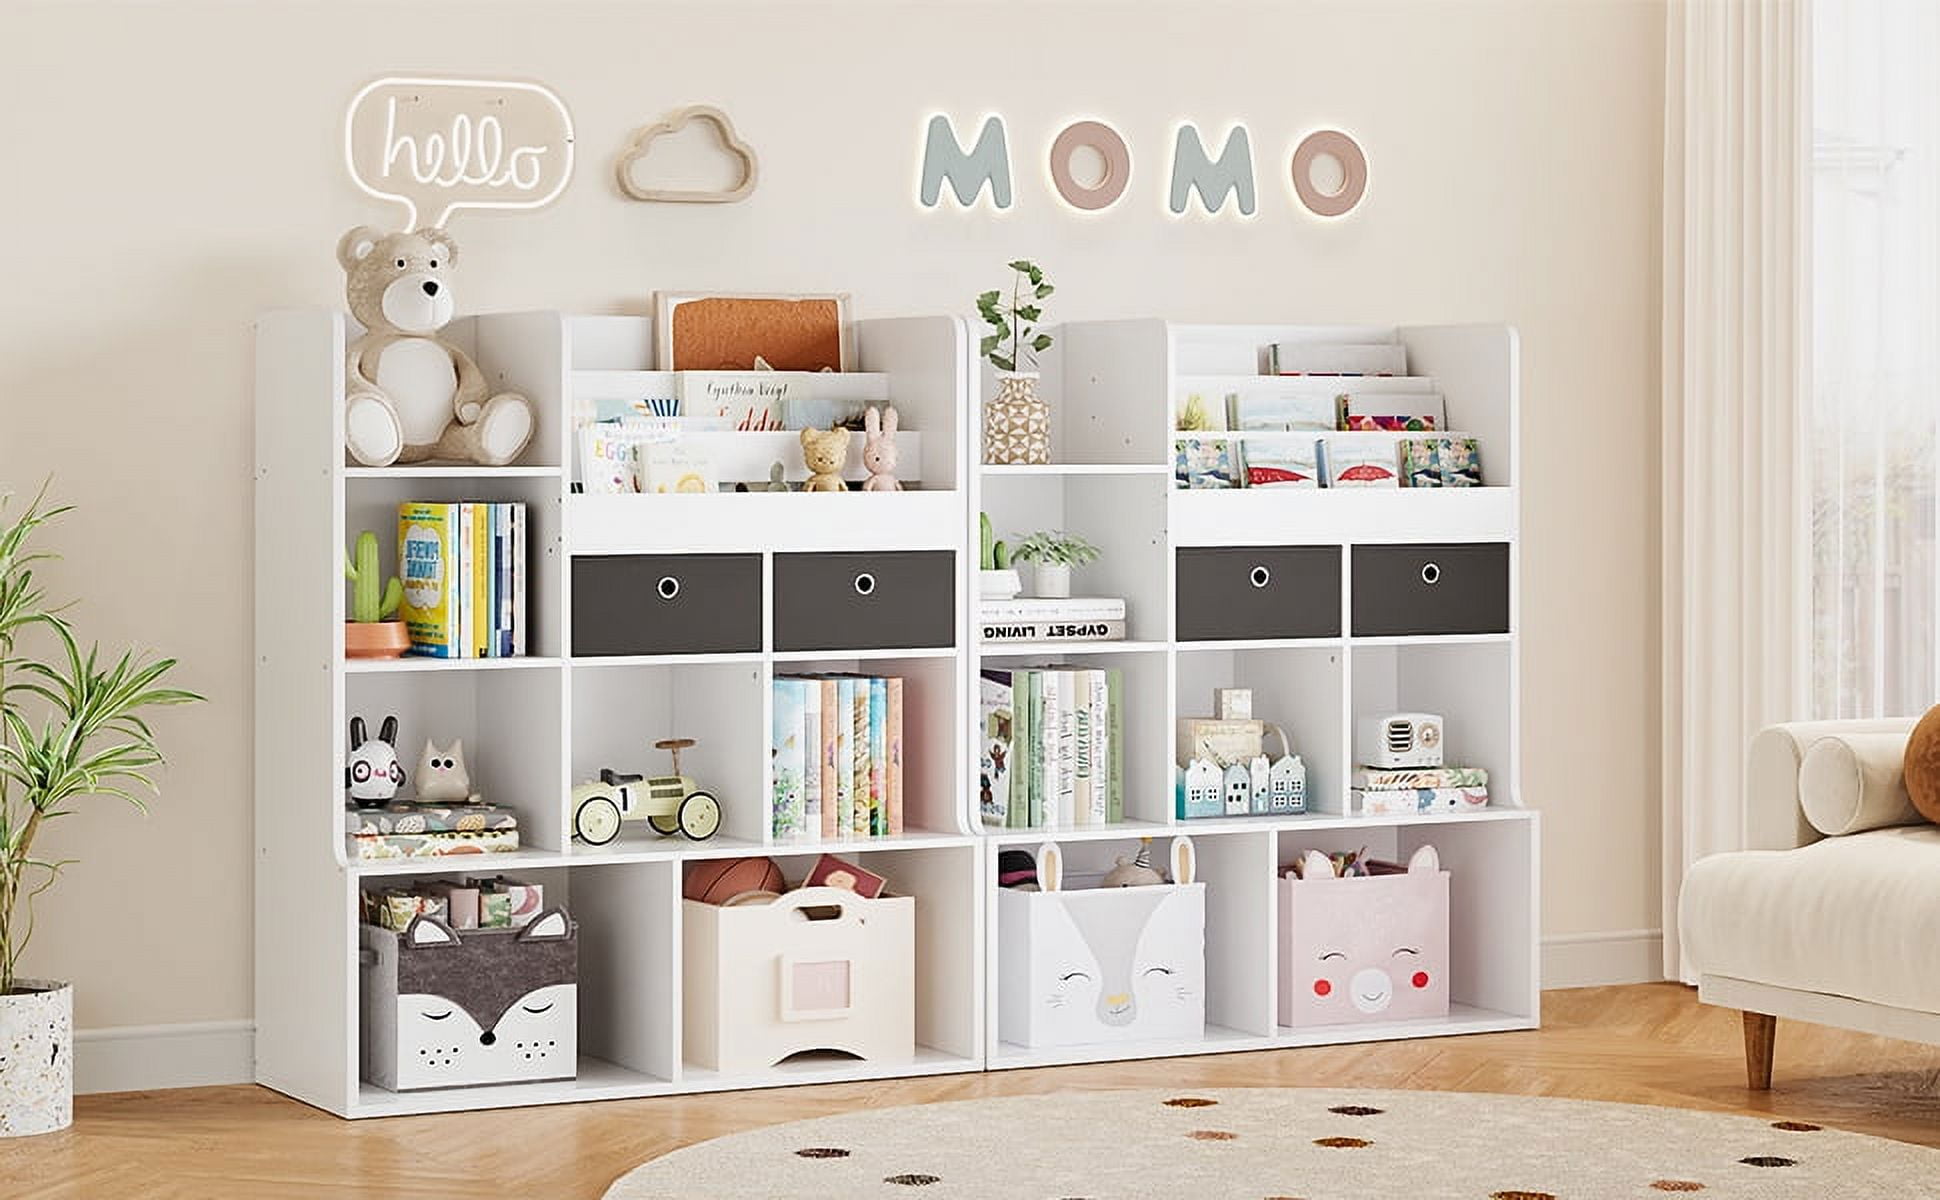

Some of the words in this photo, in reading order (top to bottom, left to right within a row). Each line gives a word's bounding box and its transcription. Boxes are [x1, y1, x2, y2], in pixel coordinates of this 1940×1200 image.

[383, 96, 548, 189] hello
[983, 626, 1035, 639] LIVING
[1046, 623, 1109, 638] GYPSET
